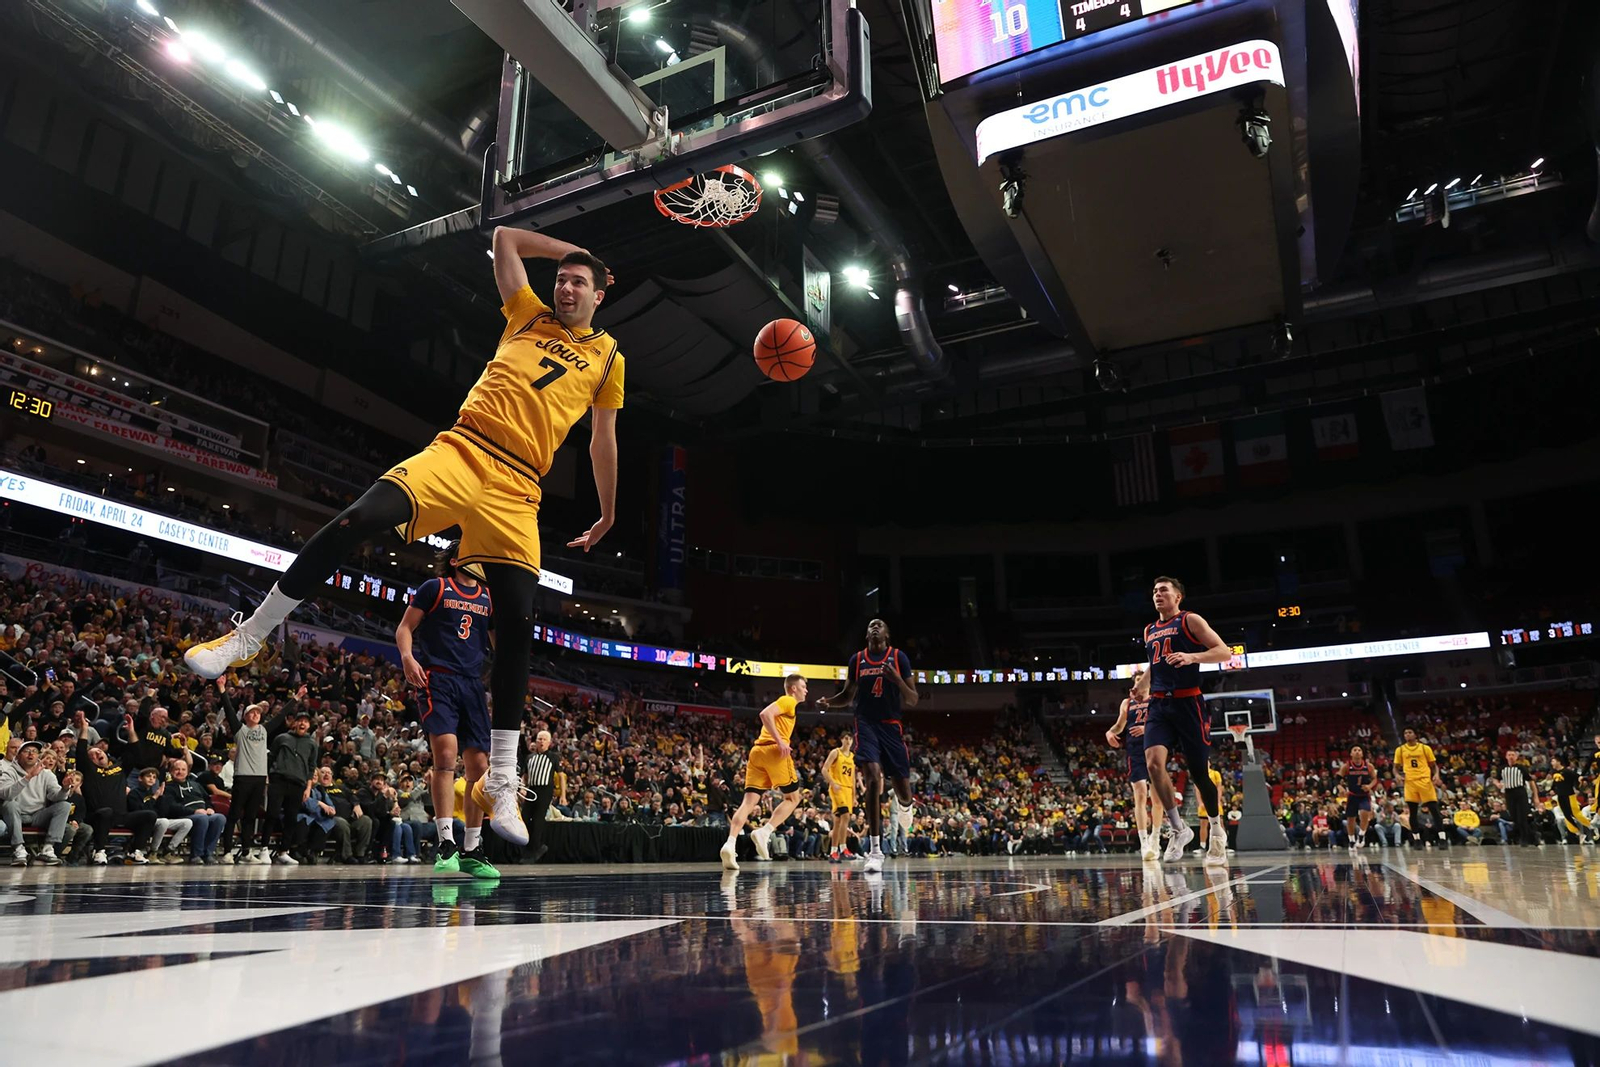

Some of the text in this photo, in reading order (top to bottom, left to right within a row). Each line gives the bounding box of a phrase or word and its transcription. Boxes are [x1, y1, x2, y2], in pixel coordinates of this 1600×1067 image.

[1070, 0, 1120, 16] TIMEO
[1076, 3, 1131, 31] 4 4
[990, 3, 1028, 43] 10
[1022, 86, 1110, 124] emc
[1033, 110, 1107, 138] INSURANCE
[535, 338, 590, 372] Iowa
[530, 356, 568, 391] 7
[9, 391, 52, 418] 12:30
[94, 421, 158, 446] FAREWAY
[196, 438, 241, 459] FAREWAY
[195, 456, 251, 475] FAREWAY
[59, 492, 143, 528] FRIDAY, APRIL 24
[670, 486, 686, 564] ULTRA
[158, 520, 229, 552] CASEY'S CENTER
[359, 581, 365, 593] 3
[402, 593, 409, 605] 4
[444, 598, 489, 617] BUCKNELL
[1278, 606, 1301, 618] 12:30
[457, 614, 473, 640] 3
[1548, 628, 1556, 638] 3
[655, 649, 667, 661] 10
[1152, 637, 1173, 665] 24
[1395, 641, 1420, 651] CENTER
[752, 663, 761, 673] 15
[972, 674, 977, 683] 7
[871, 676, 883, 698] 4
[842, 766, 852, 777] 24
[1411, 759, 1418, 768] 6
